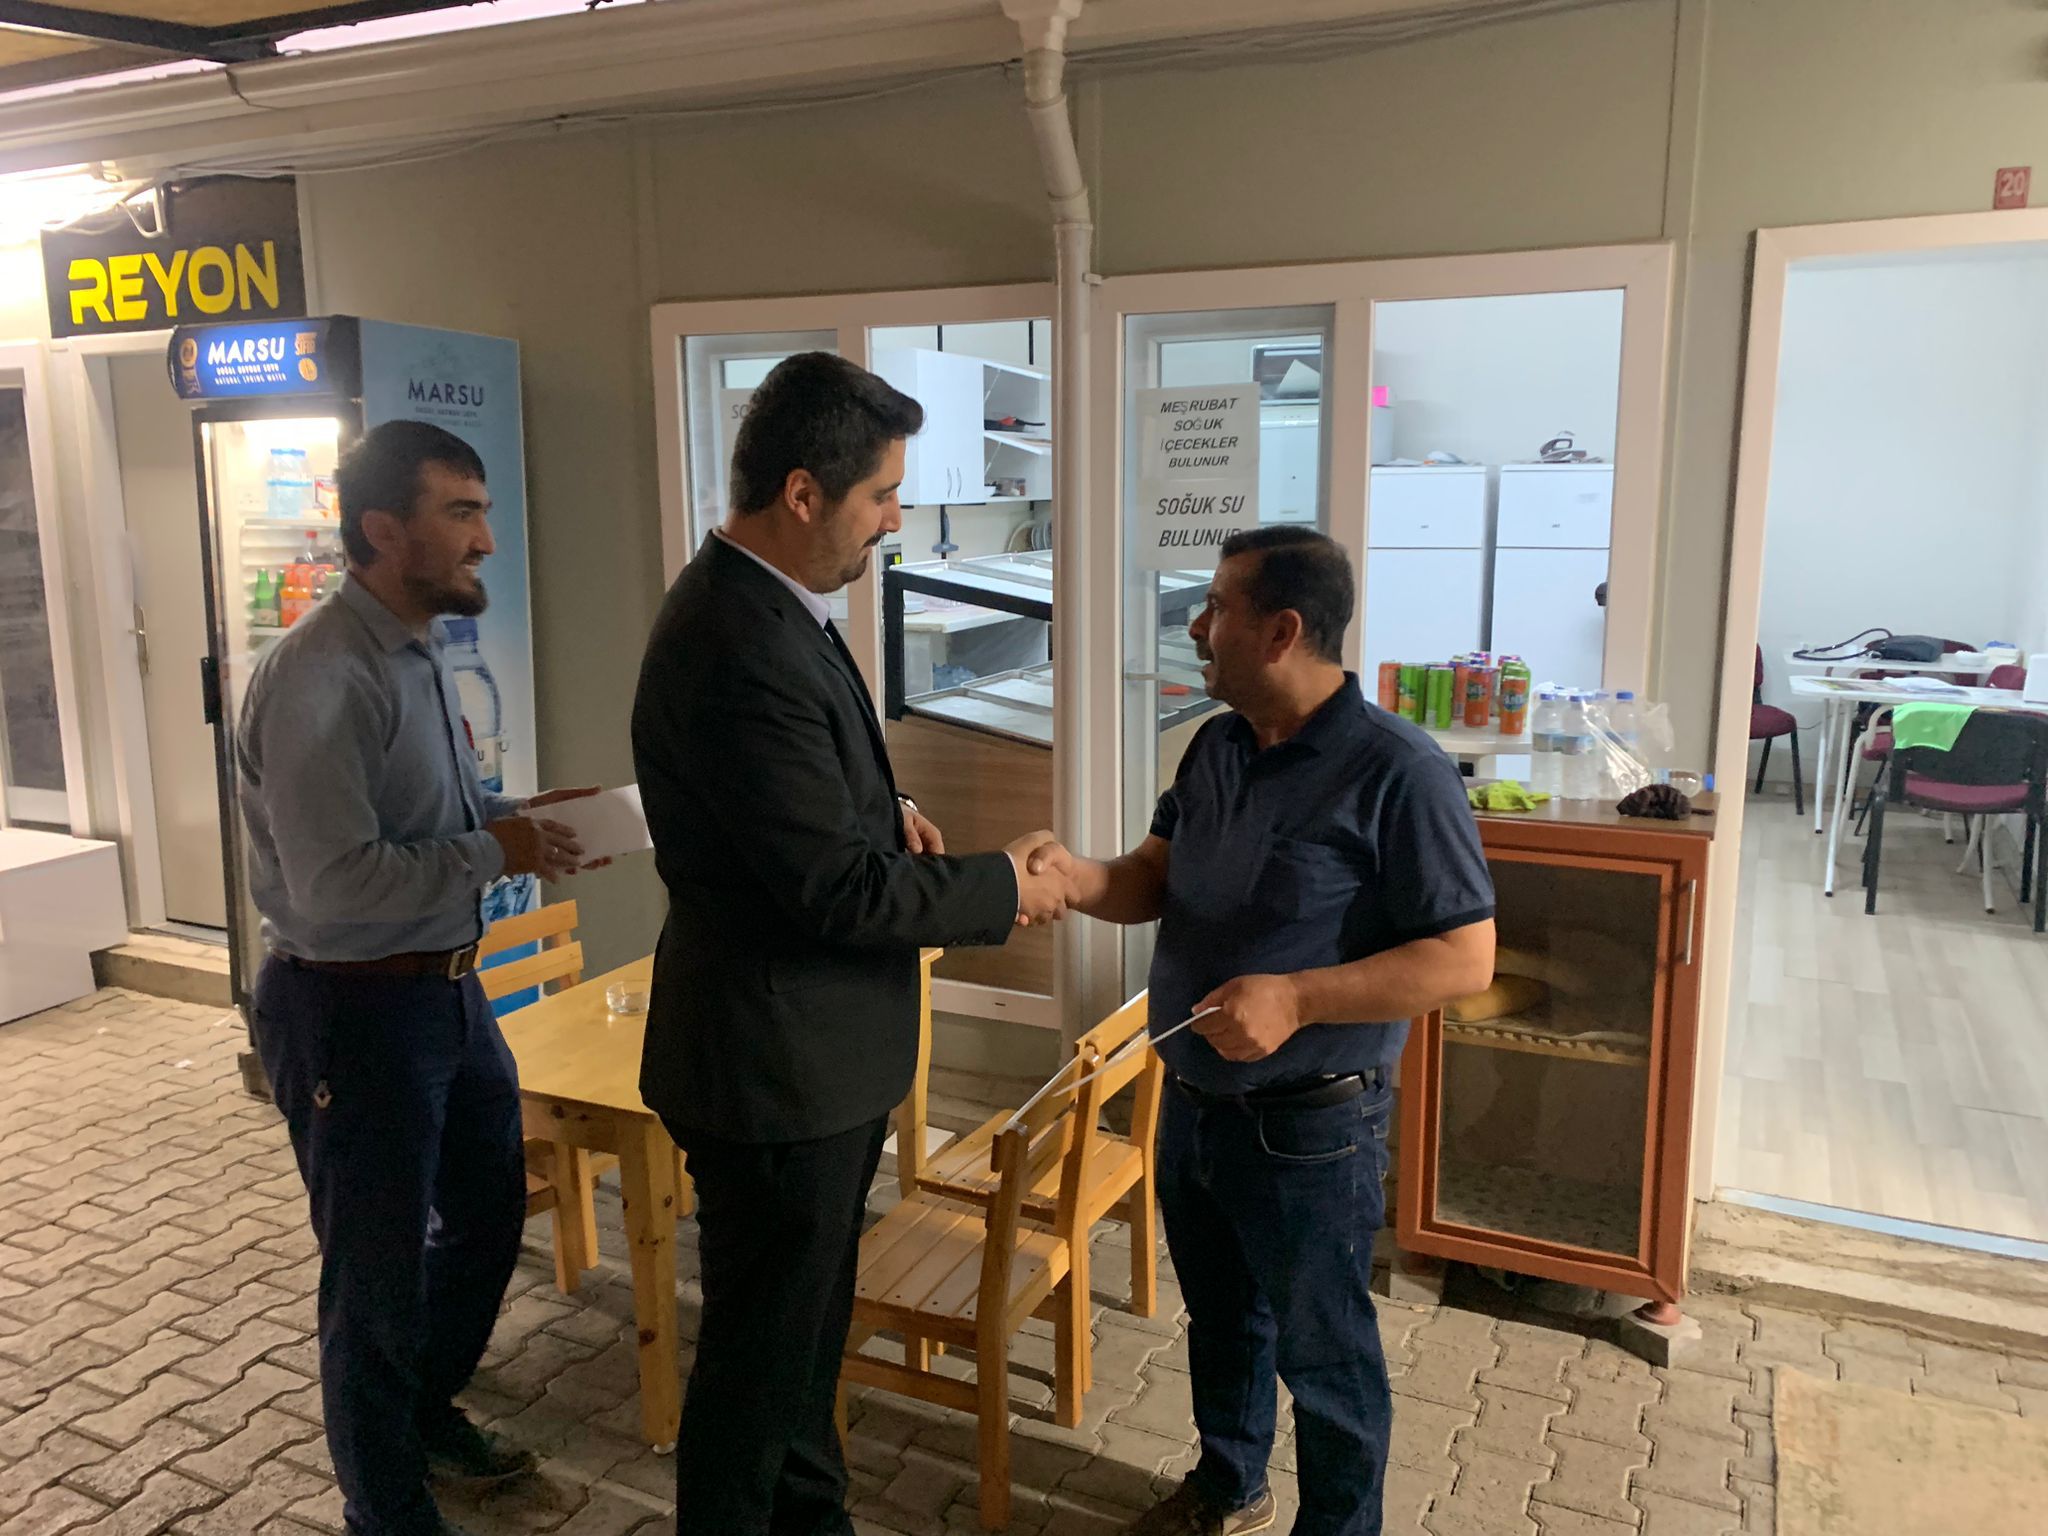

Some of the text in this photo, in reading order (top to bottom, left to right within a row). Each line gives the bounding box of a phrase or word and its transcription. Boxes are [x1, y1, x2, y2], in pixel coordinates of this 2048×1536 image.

[68, 240, 279, 324] REYON
[207, 336, 285, 365] MARSU
[408, 377, 484, 407] MARSU
[1160, 398, 1239, 415] MEŞRUBAT
[1173, 417, 1224, 431] SOĞUK
[1168, 455, 1229, 468] BULUNUR
[1156, 493, 1245, 516] SOĞUK SU
